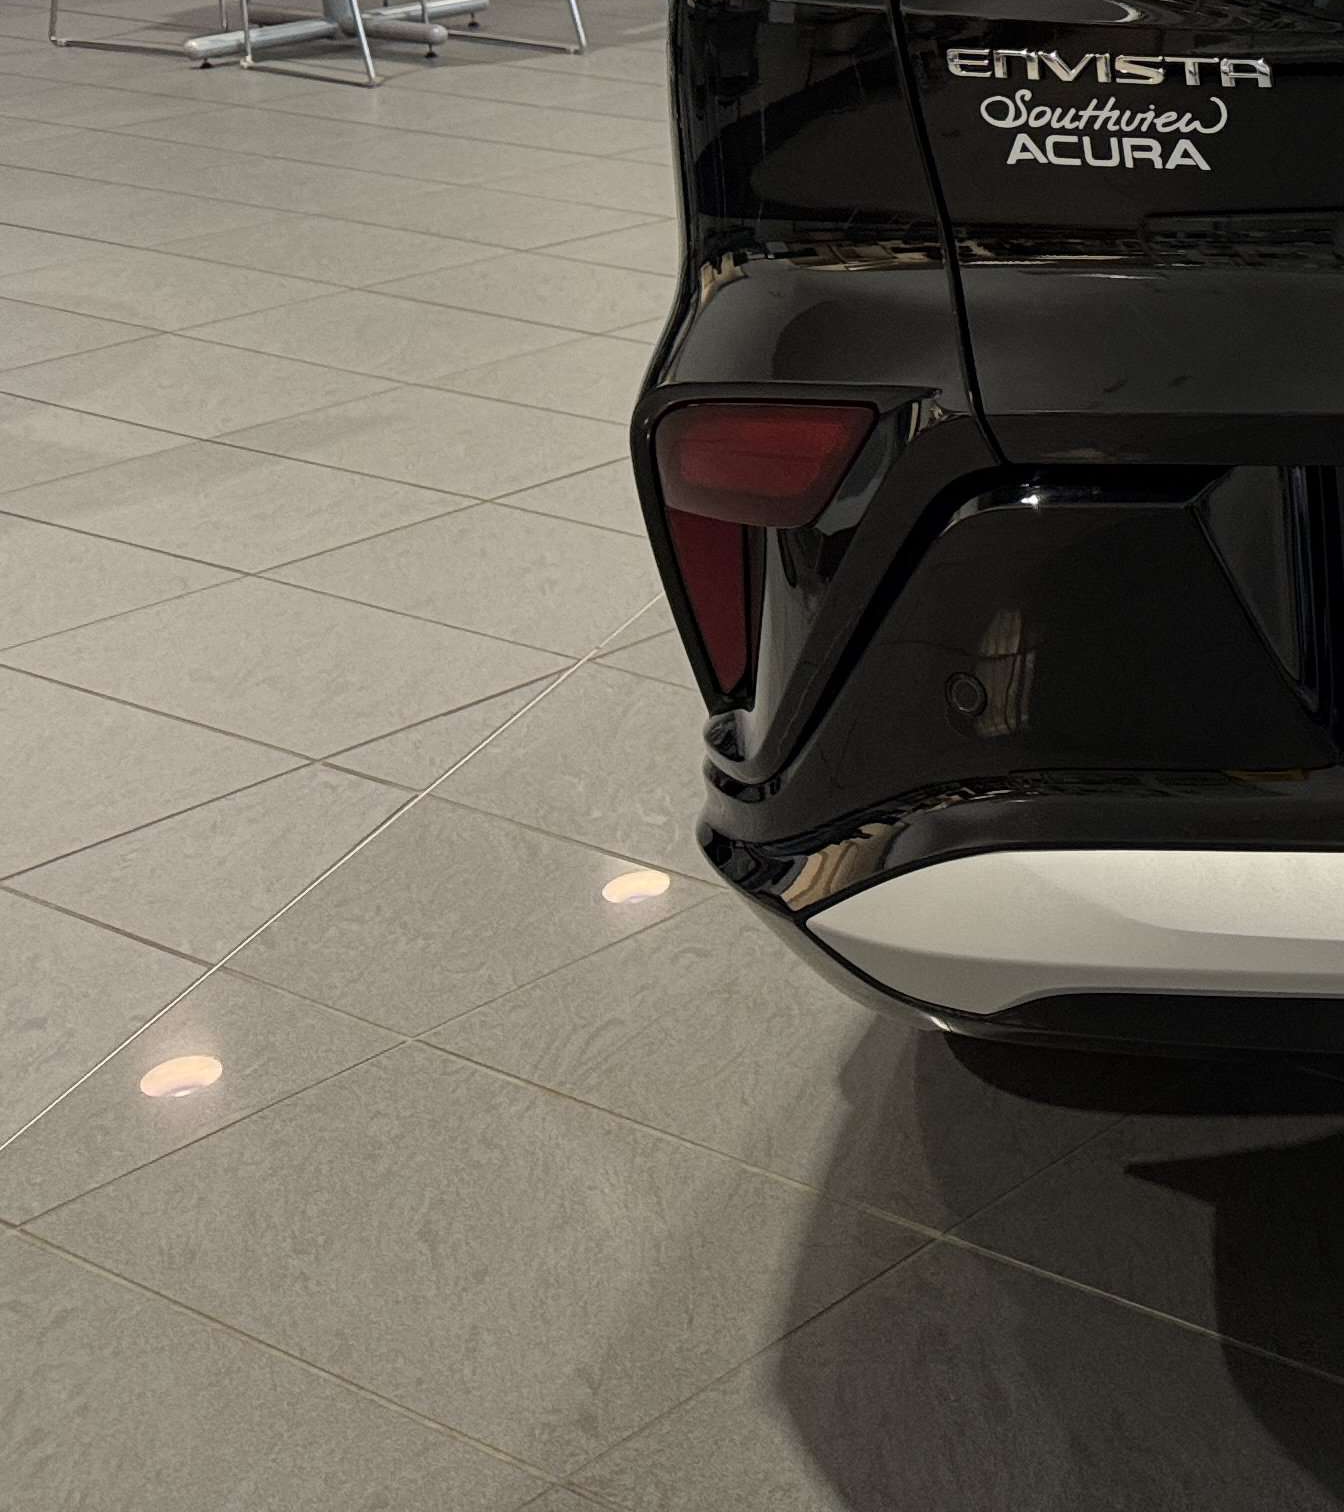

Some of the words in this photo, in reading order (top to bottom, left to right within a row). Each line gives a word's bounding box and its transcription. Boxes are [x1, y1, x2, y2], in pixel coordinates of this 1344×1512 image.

[946, 48, 1273, 89] ENVISTA
[980, 88, 1228, 134] Southview
[1006, 133, 1211, 171] ACURA
